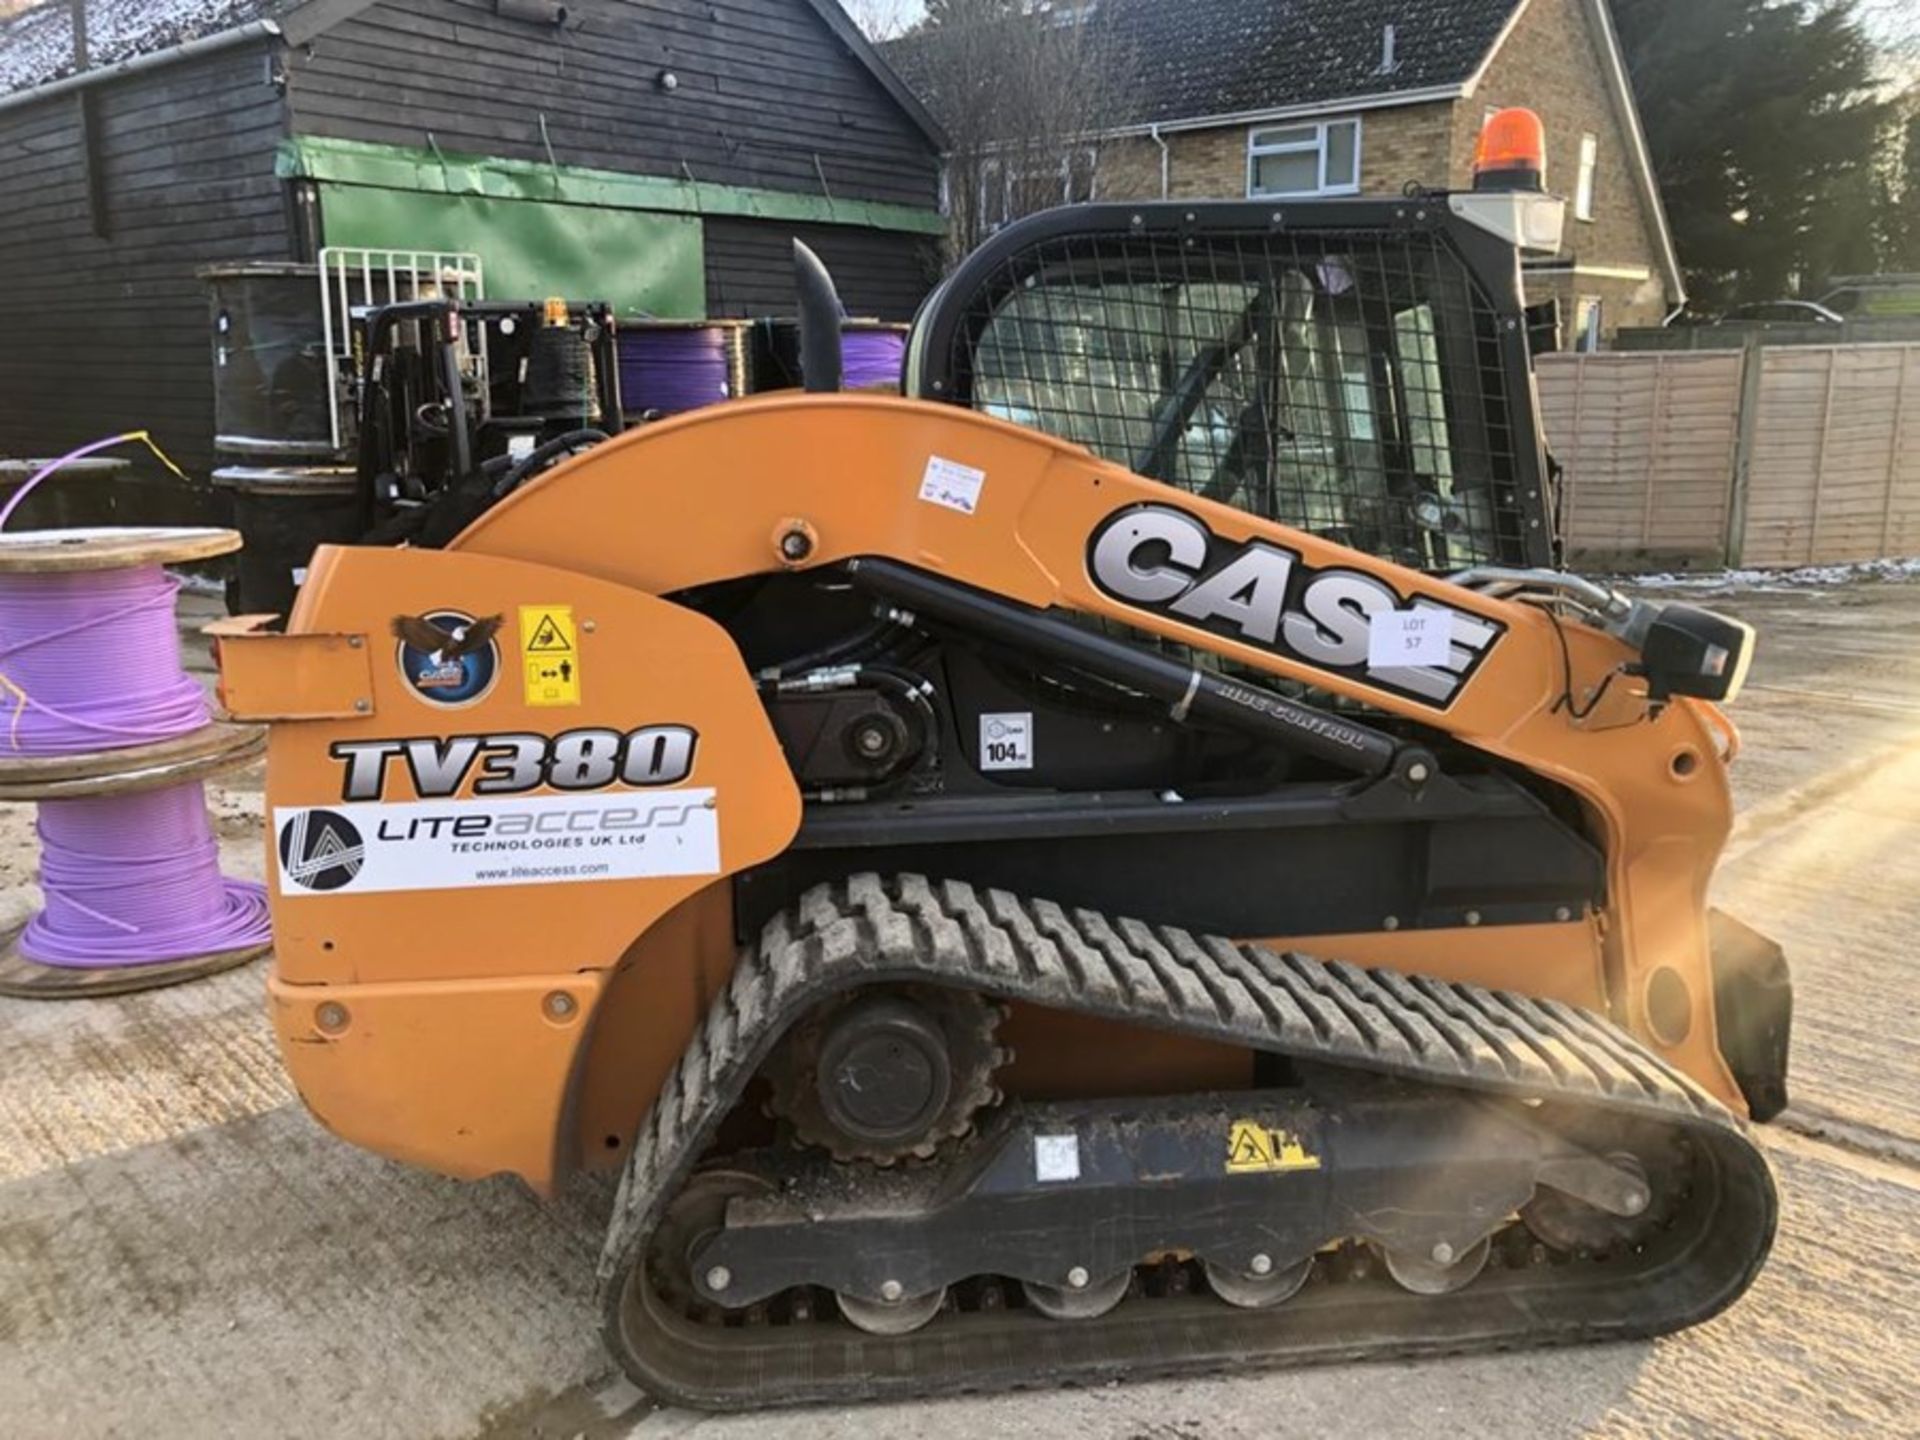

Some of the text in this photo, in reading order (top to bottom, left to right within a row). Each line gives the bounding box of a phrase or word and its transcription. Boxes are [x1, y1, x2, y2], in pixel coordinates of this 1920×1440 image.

[1090, 502, 1503, 707] CASE
[1402, 618, 1426, 631] LOT
[1405, 637, 1422, 649] 57
[1269, 705, 1365, 750] CONTROL
[987, 742, 1017, 762] 104
[329, 724, 698, 801] TV380
[451, 833, 646, 853] TECHNOLOGIES UK Ltd
[475, 862, 610, 881] www.liteaccess.com
